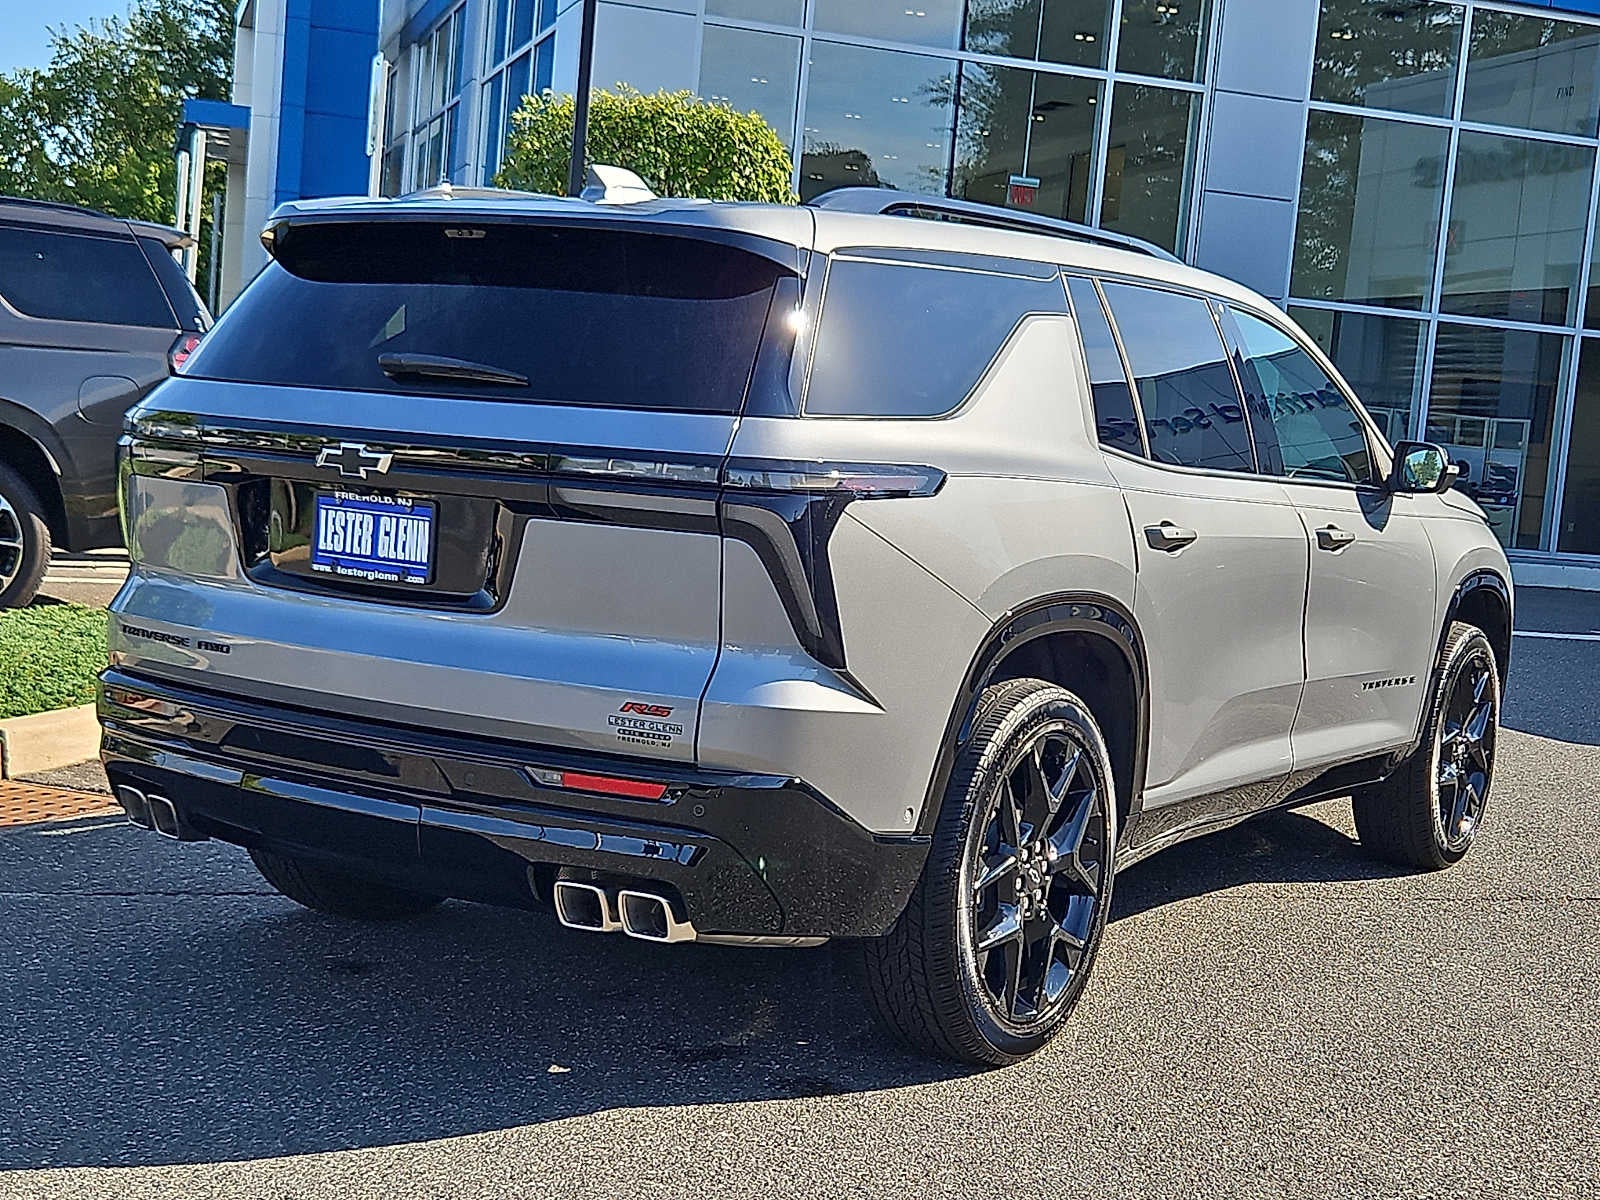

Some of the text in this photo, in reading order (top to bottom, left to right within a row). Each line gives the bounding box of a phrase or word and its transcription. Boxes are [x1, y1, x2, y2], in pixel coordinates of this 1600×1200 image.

[397, 497, 413, 507] NJ
[318, 508, 430, 563] LESTER GLENN
[121, 624, 190, 647] TRAVERSE
[619, 701, 675, 718] RS
